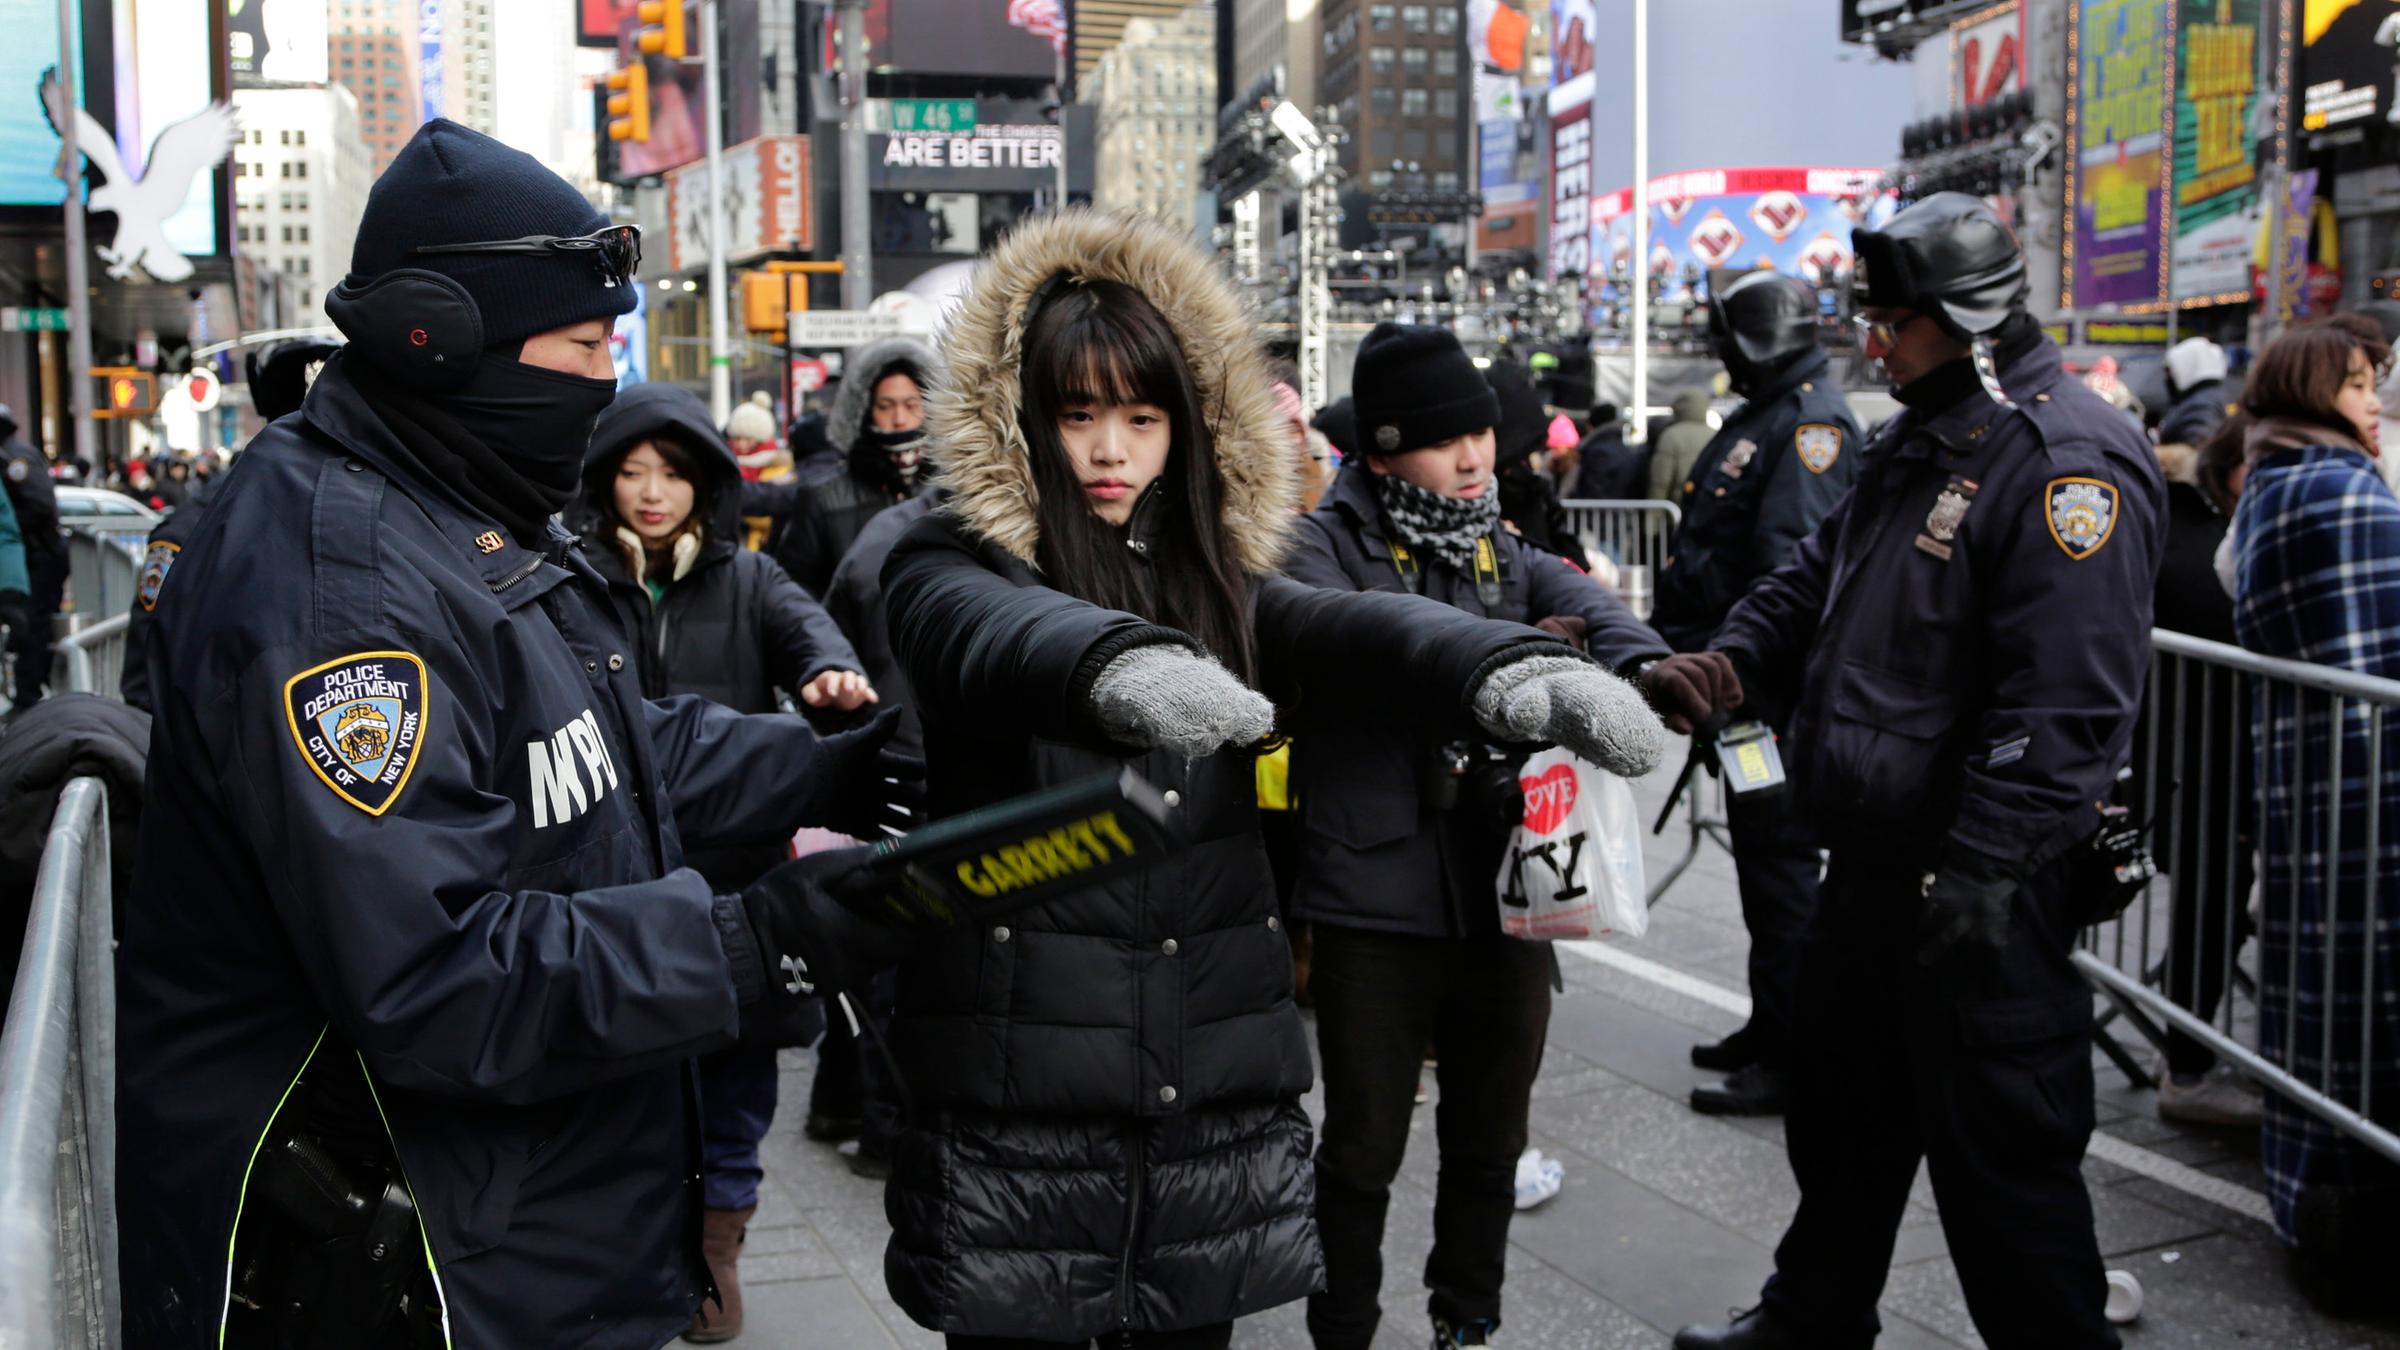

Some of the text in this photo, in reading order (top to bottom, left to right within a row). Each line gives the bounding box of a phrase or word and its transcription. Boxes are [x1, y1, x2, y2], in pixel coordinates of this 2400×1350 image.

[895, 103, 916, 128] W
[923, 103, 951, 128] 46
[884, 138, 1061, 168] ARE BETTER
[776, 141, 800, 242] HELLO
[304, 681, 409, 721] DEPARTMENT
[324, 664, 386, 691] POLICE
[309, 735, 357, 786] CITY OF
[381, 710, 418, 785] NEW YORK
[527, 709, 618, 829] NYPD
[956, 811, 1135, 897] GARRETT
